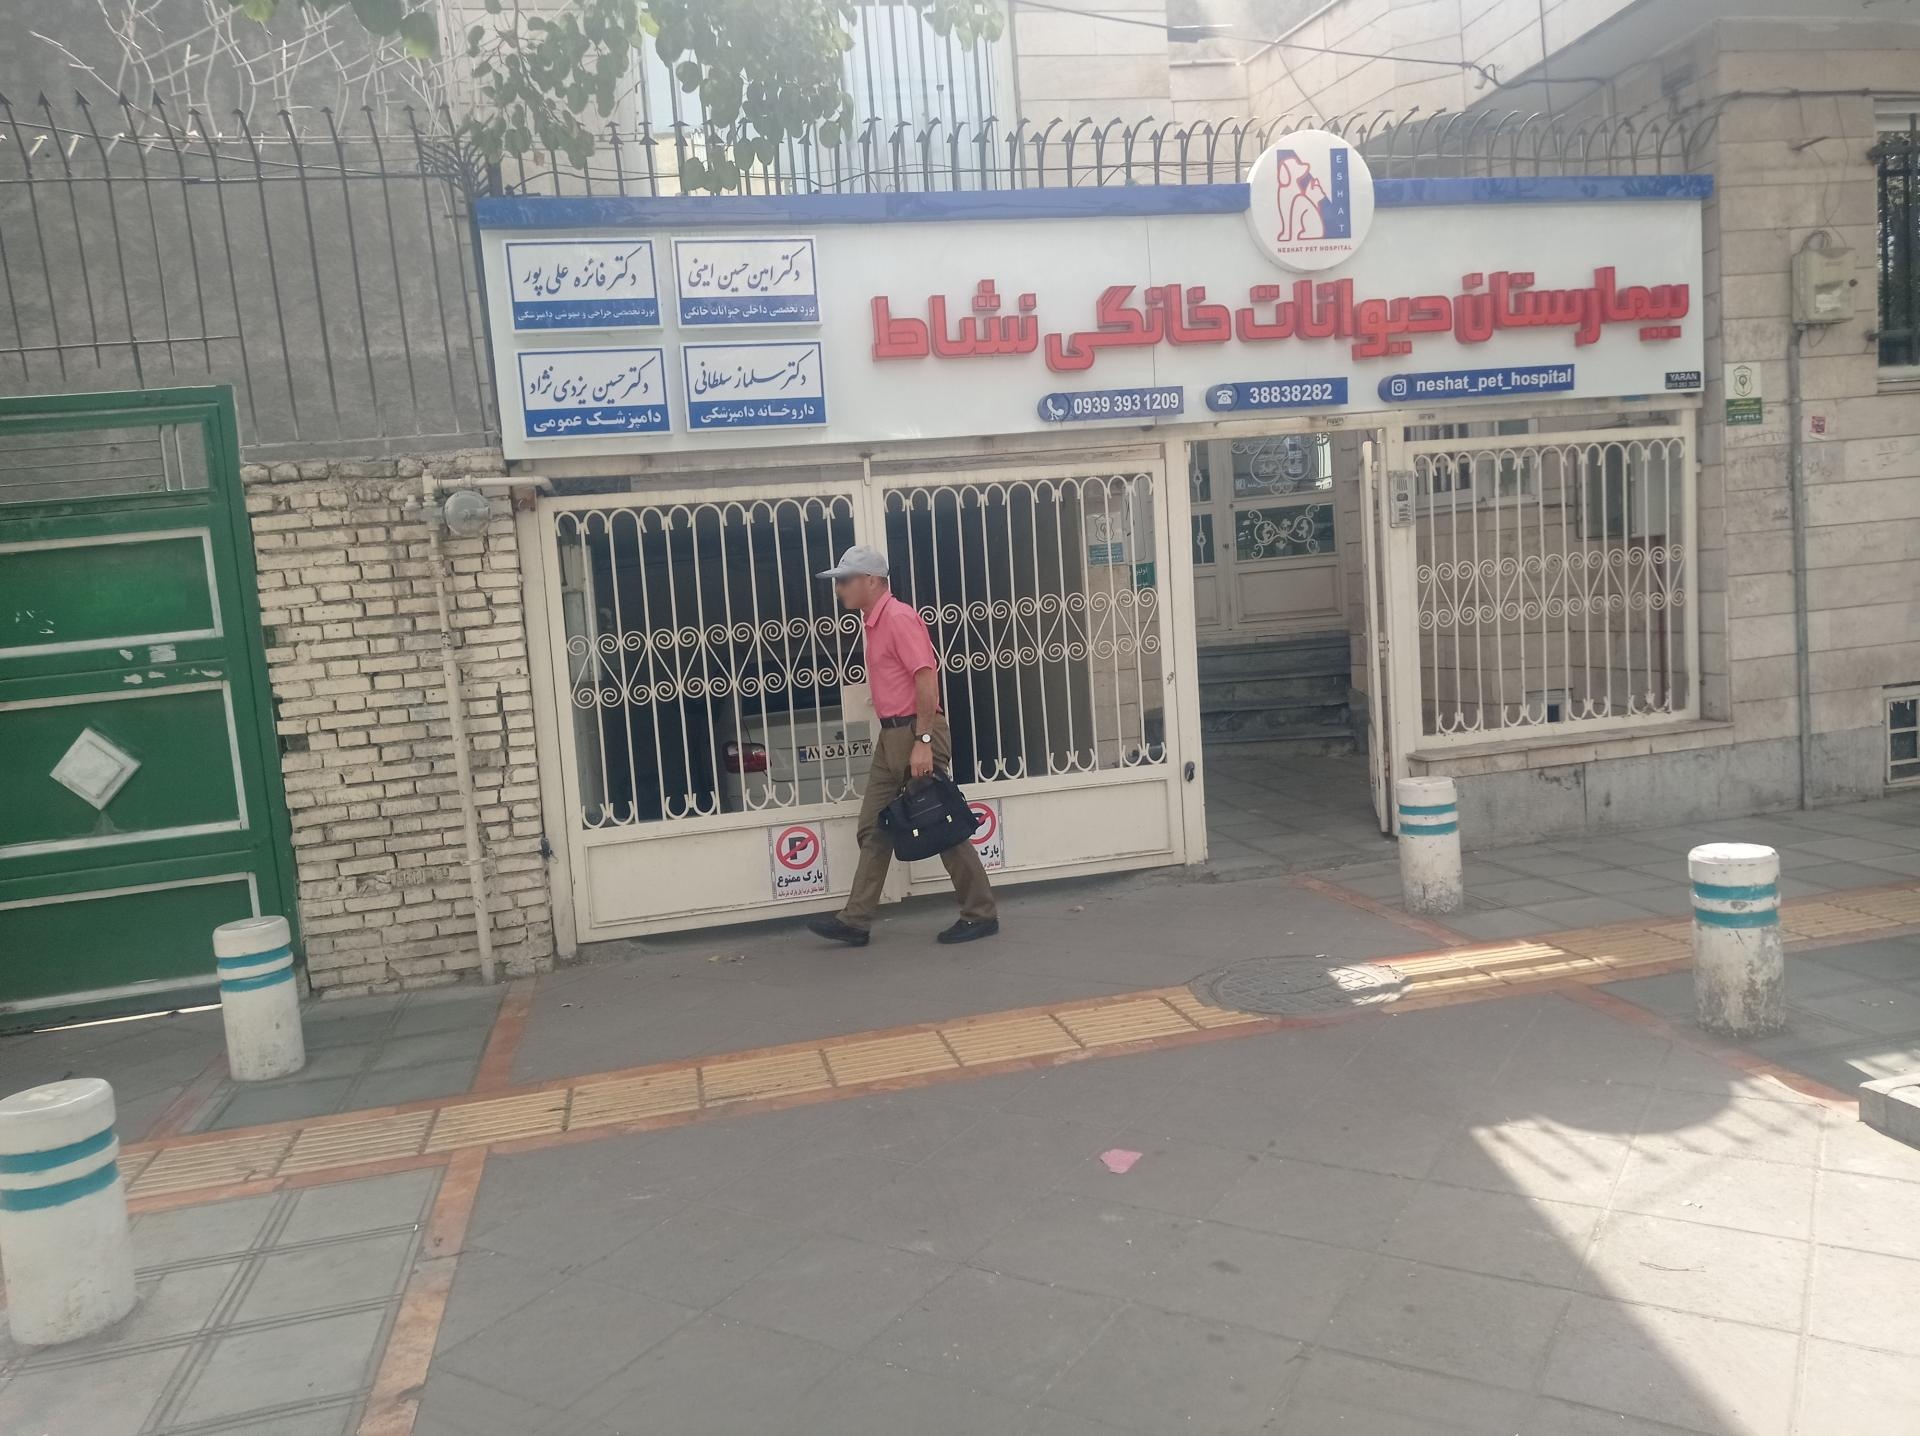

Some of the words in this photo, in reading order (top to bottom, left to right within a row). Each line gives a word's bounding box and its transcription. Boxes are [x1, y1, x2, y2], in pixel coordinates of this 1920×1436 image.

[1277, 246, 1303, 254] NESHAT
[1319, 244, 1353, 252] HOSPITAL
[574, 258, 606, 288] فائزه
[606, 246, 643, 291] دکتر
[688, 258, 714, 287] امینی
[717, 263, 749, 292] حسین
[773, 246, 806, 286] دکتر
[523, 266, 543, 296] پور
[546, 263, 569, 294] علی
[747, 265, 774, 292] امین
[588, 308, 612, 319] جراحی
[684, 305, 709, 319] خانگی
[711, 305, 740, 318] حیوانات
[743, 305, 768, 318] داخلی
[769, 304, 798, 317] تخصصی
[800, 304, 816, 317] بورد
[1453, 266, 1689, 347] بیمارستان
[871, 279, 1039, 361] نشاط
[1044, 284, 1232, 372] خانگی
[1235, 278, 1453, 362] حیوانات
[529, 365, 554, 395] نژاد
[620, 356, 656, 399] دکتر
[695, 361, 732, 395] سلطانی
[734, 366, 786, 389] سلماز
[780, 349, 814, 390] دکتر
[1416, 369, 1572, 392] neshat_pet_hospital
[1670, 372, 1697, 381] YARAN
[553, 375, 587, 405] یزدی
[592, 374, 626, 404] حسین
[1249, 384, 1333, 404] 38838282
[701, 405, 755, 423] دامپزشکی
[757, 403, 815, 419] داروخانه
[1073, 395, 1110, 415] 0939
[1113, 393, 1141, 413] 393
[1143, 392, 1179, 411] 1209
[533, 415, 582, 433] عمومی
[586, 409, 662, 429] دامپزشک
[825, 745, 835, 758] ق
[788, 836, 809, 860] P
[981, 845, 999, 858] پارک
[777, 874, 801, 889] ممنوع
[803, 869, 823, 884] پارک
